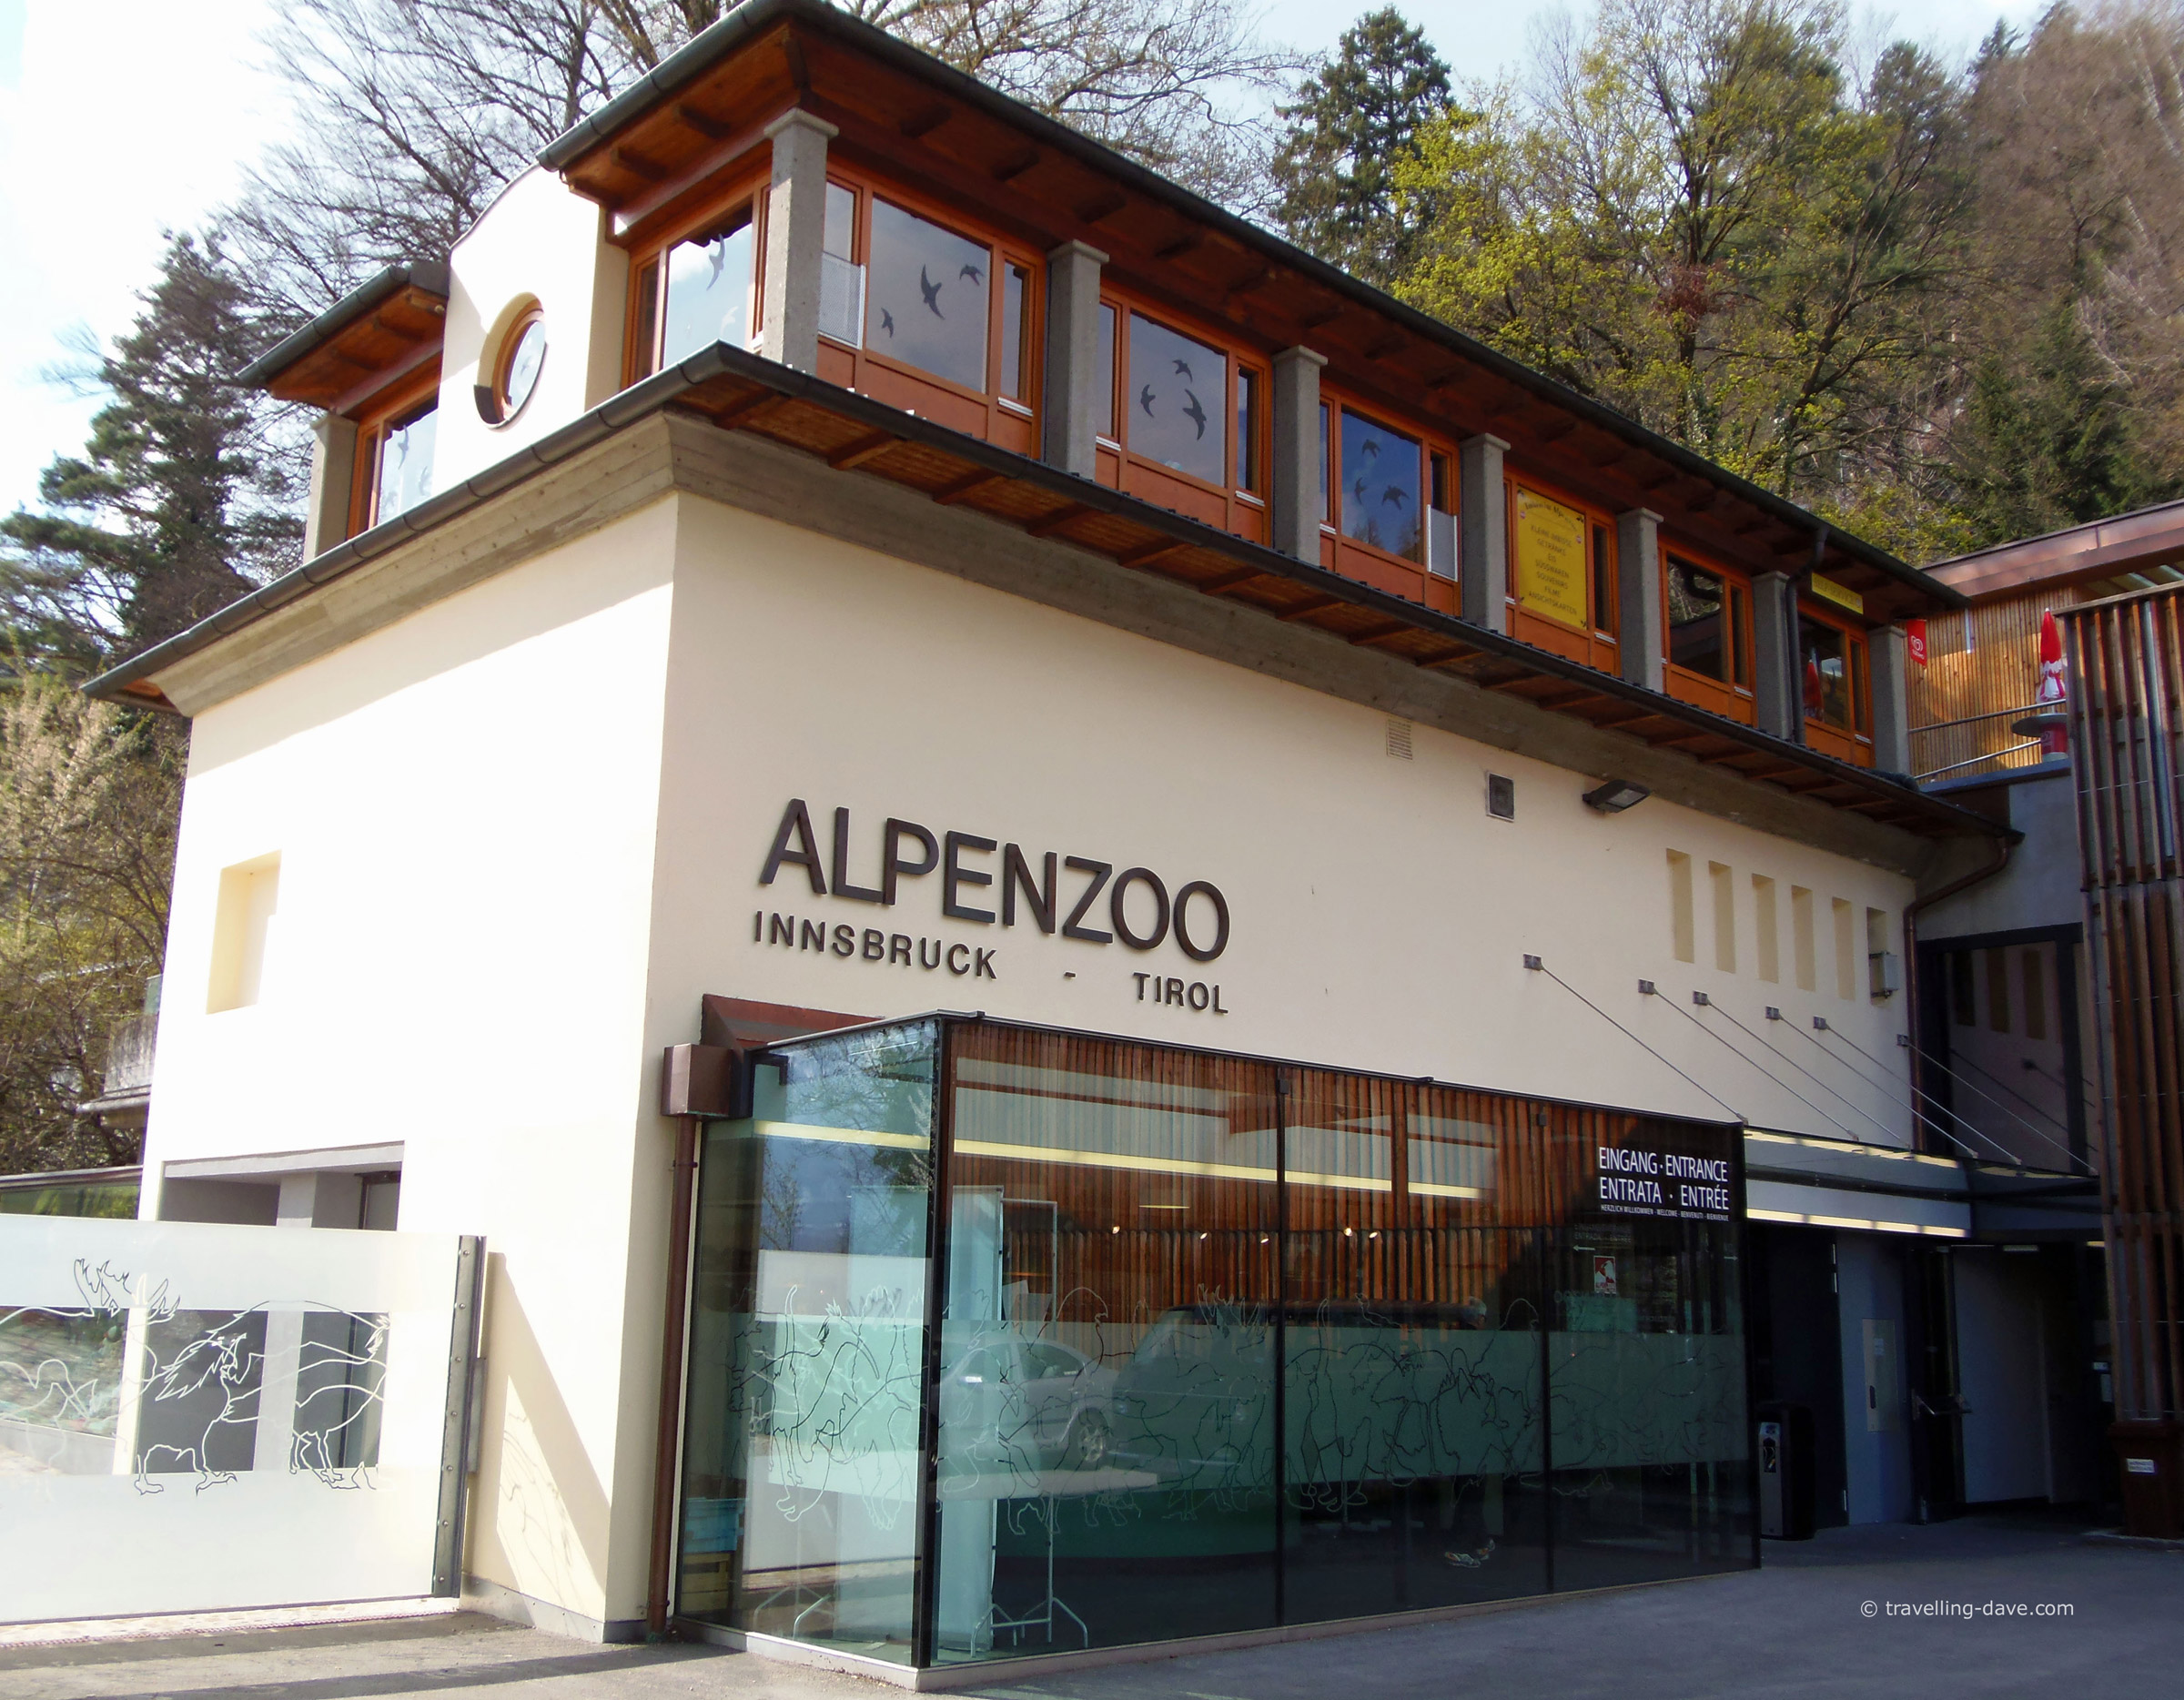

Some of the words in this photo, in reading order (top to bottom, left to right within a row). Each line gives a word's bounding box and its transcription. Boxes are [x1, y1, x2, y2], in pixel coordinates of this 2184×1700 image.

[759, 798, 1230, 962] ALPENZOO
[754, 910, 997, 980] INNSBRUCK
[1133, 971, 1228, 1014] TIROL
[1599, 1147, 1657, 1175] EINGANG
[1664, 1154, 1729, 1182] ENTRANCE
[1600, 1176, 1663, 1204] ENTRATA
[1681, 1184, 1729, 1210] ENTRÉE
[1601, 1203, 1623, 1213] HERZLICH
[1623, 1206, 1654, 1215] WILLKOMMEN
[1657, 1209, 1678, 1218] WELCOME
